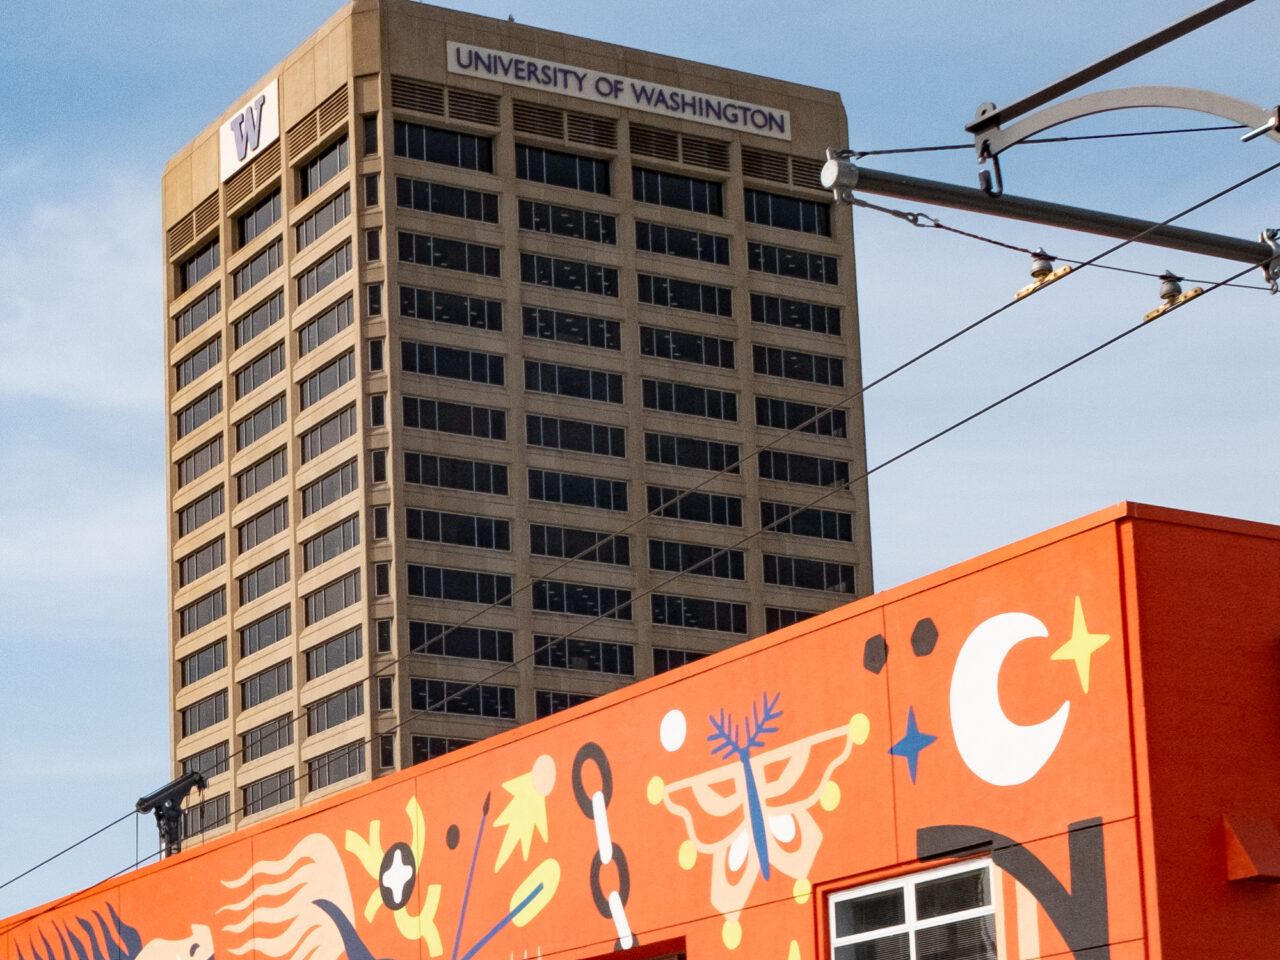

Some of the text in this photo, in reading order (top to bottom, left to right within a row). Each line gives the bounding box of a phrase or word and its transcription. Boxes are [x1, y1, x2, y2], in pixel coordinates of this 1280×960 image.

[230, 94, 266, 162] W
[456, 47, 785, 134] UNIVERSITY OF WASHINGTON
